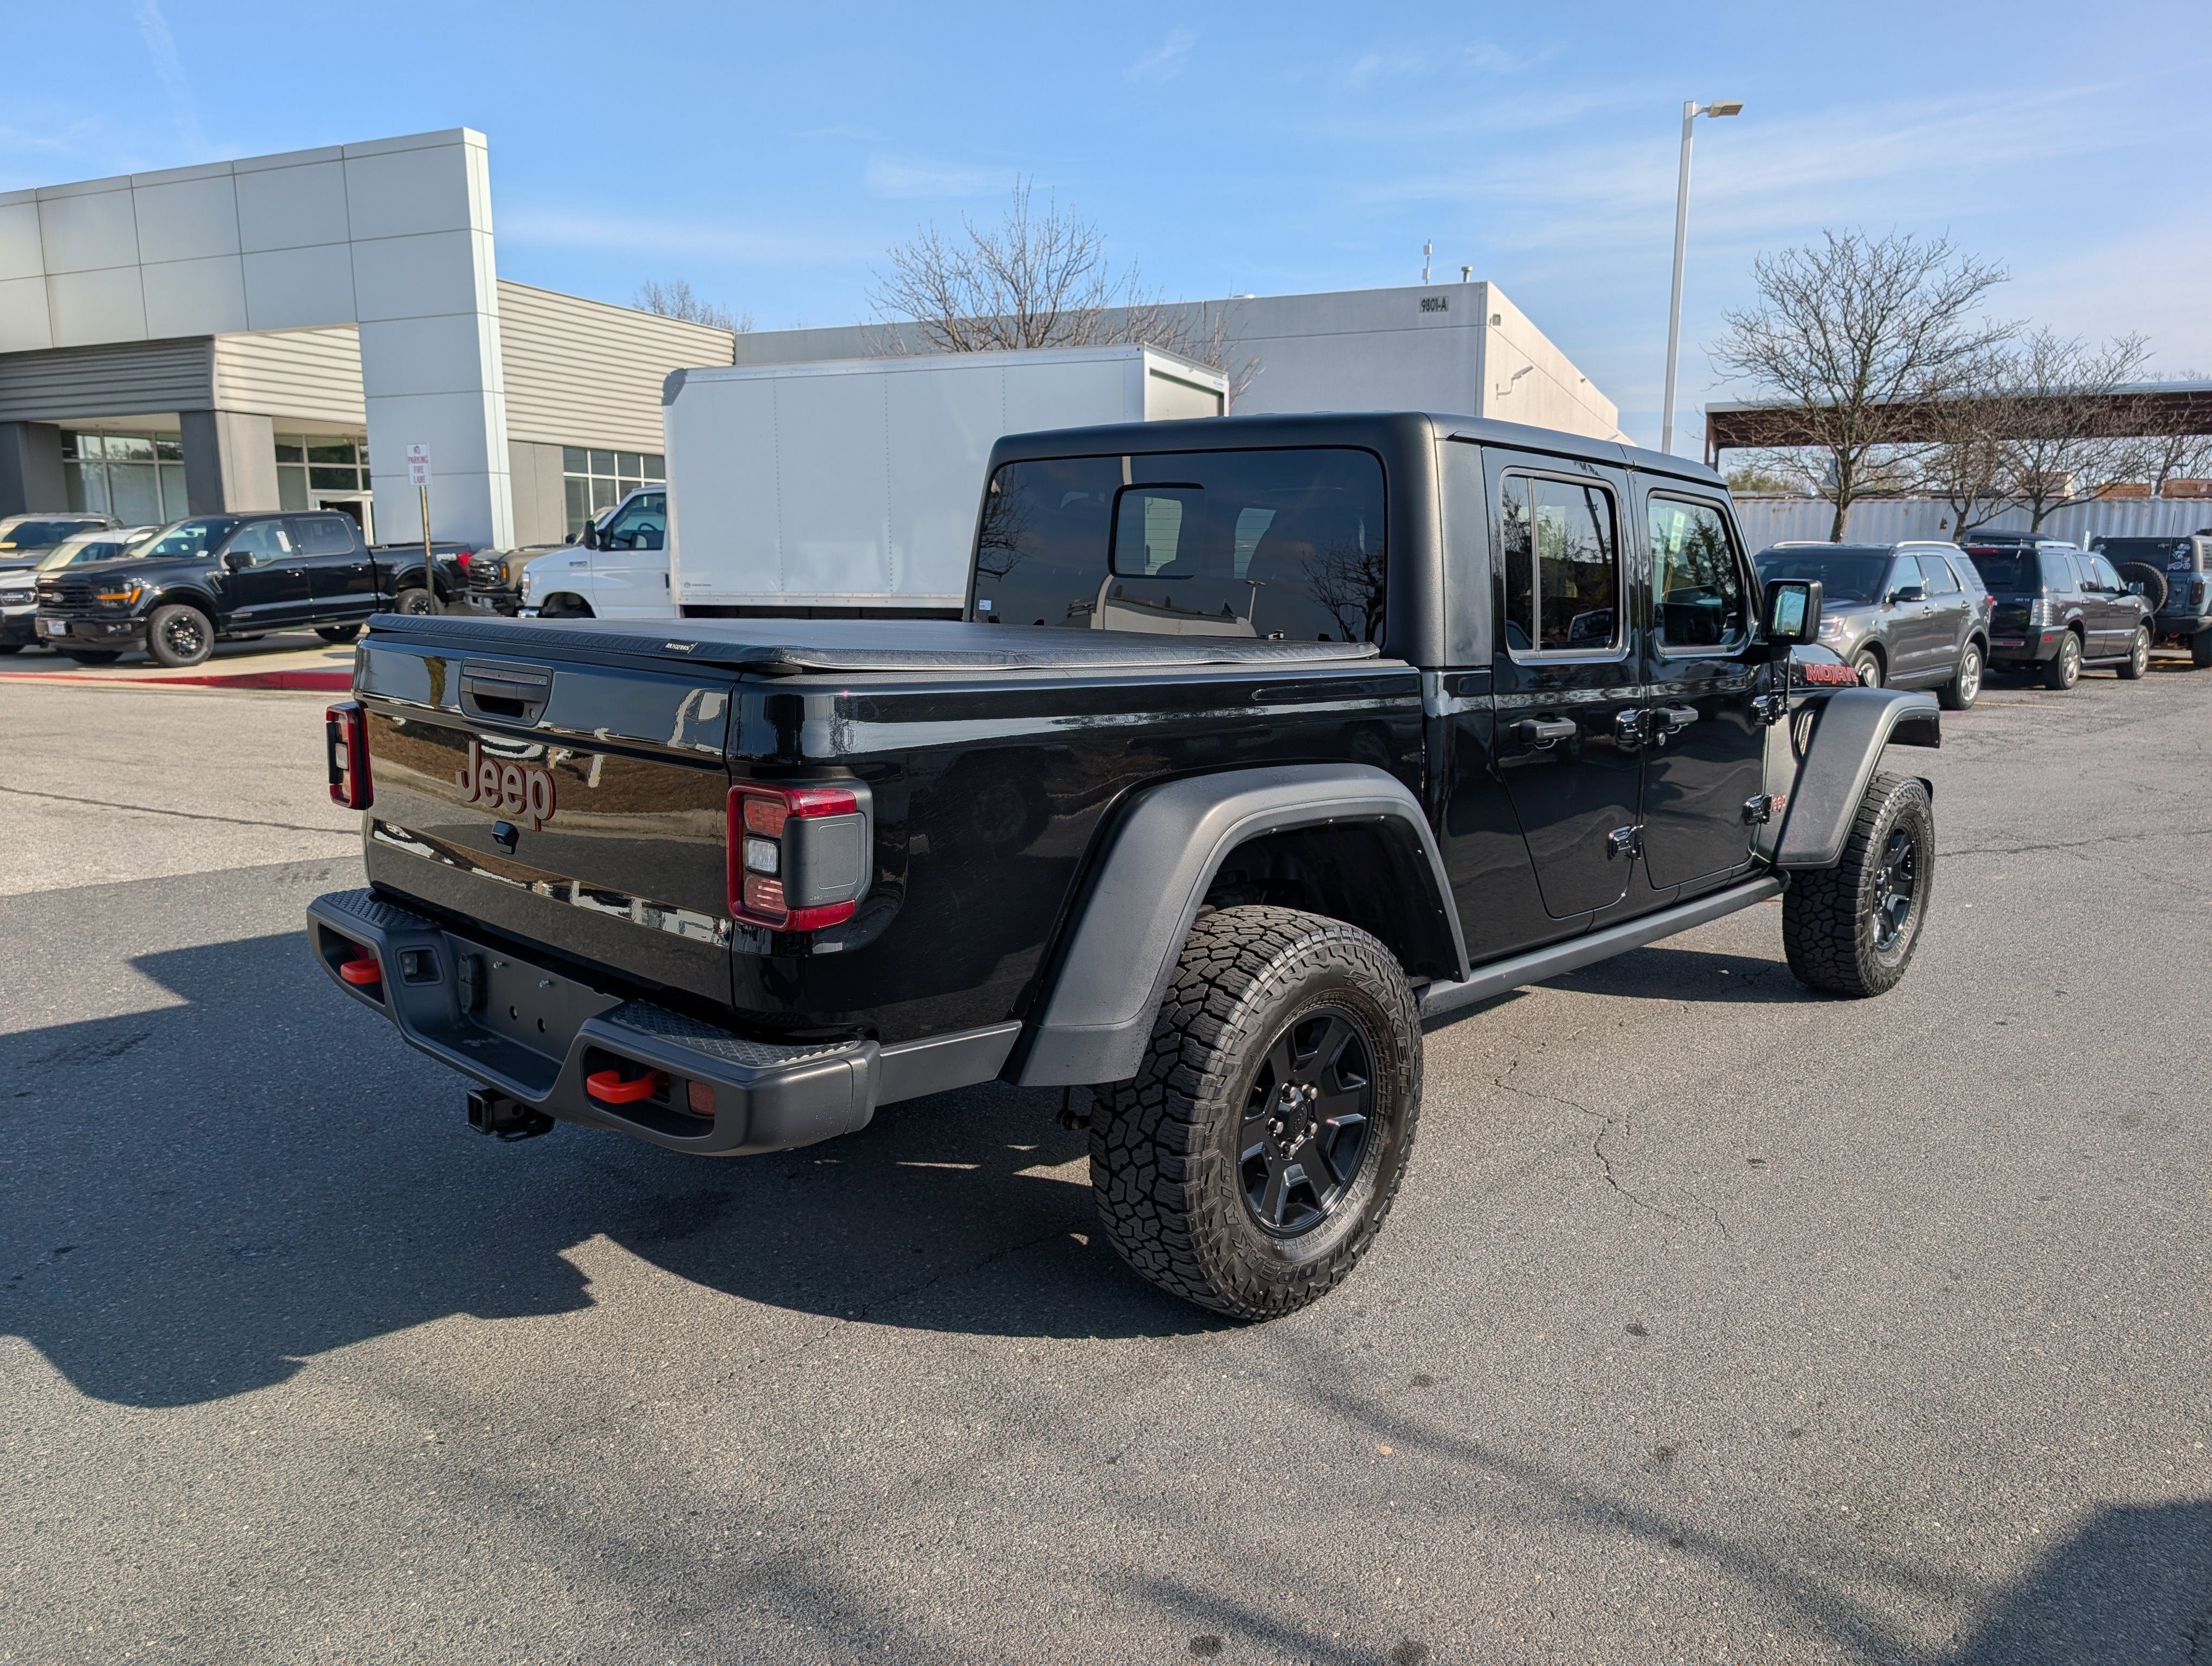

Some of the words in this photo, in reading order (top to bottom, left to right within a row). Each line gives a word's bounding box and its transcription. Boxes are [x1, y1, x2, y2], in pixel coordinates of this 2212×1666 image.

[1421, 298, 1446, 312] 9801-A
[414, 465, 424, 473] FIRE
[414, 475, 426, 484] LANE
[454, 740, 557, 832] Jeep
[1343, 970, 1411, 1095] FALKEN
[1232, 1216, 1364, 1284] WILDPEAK
